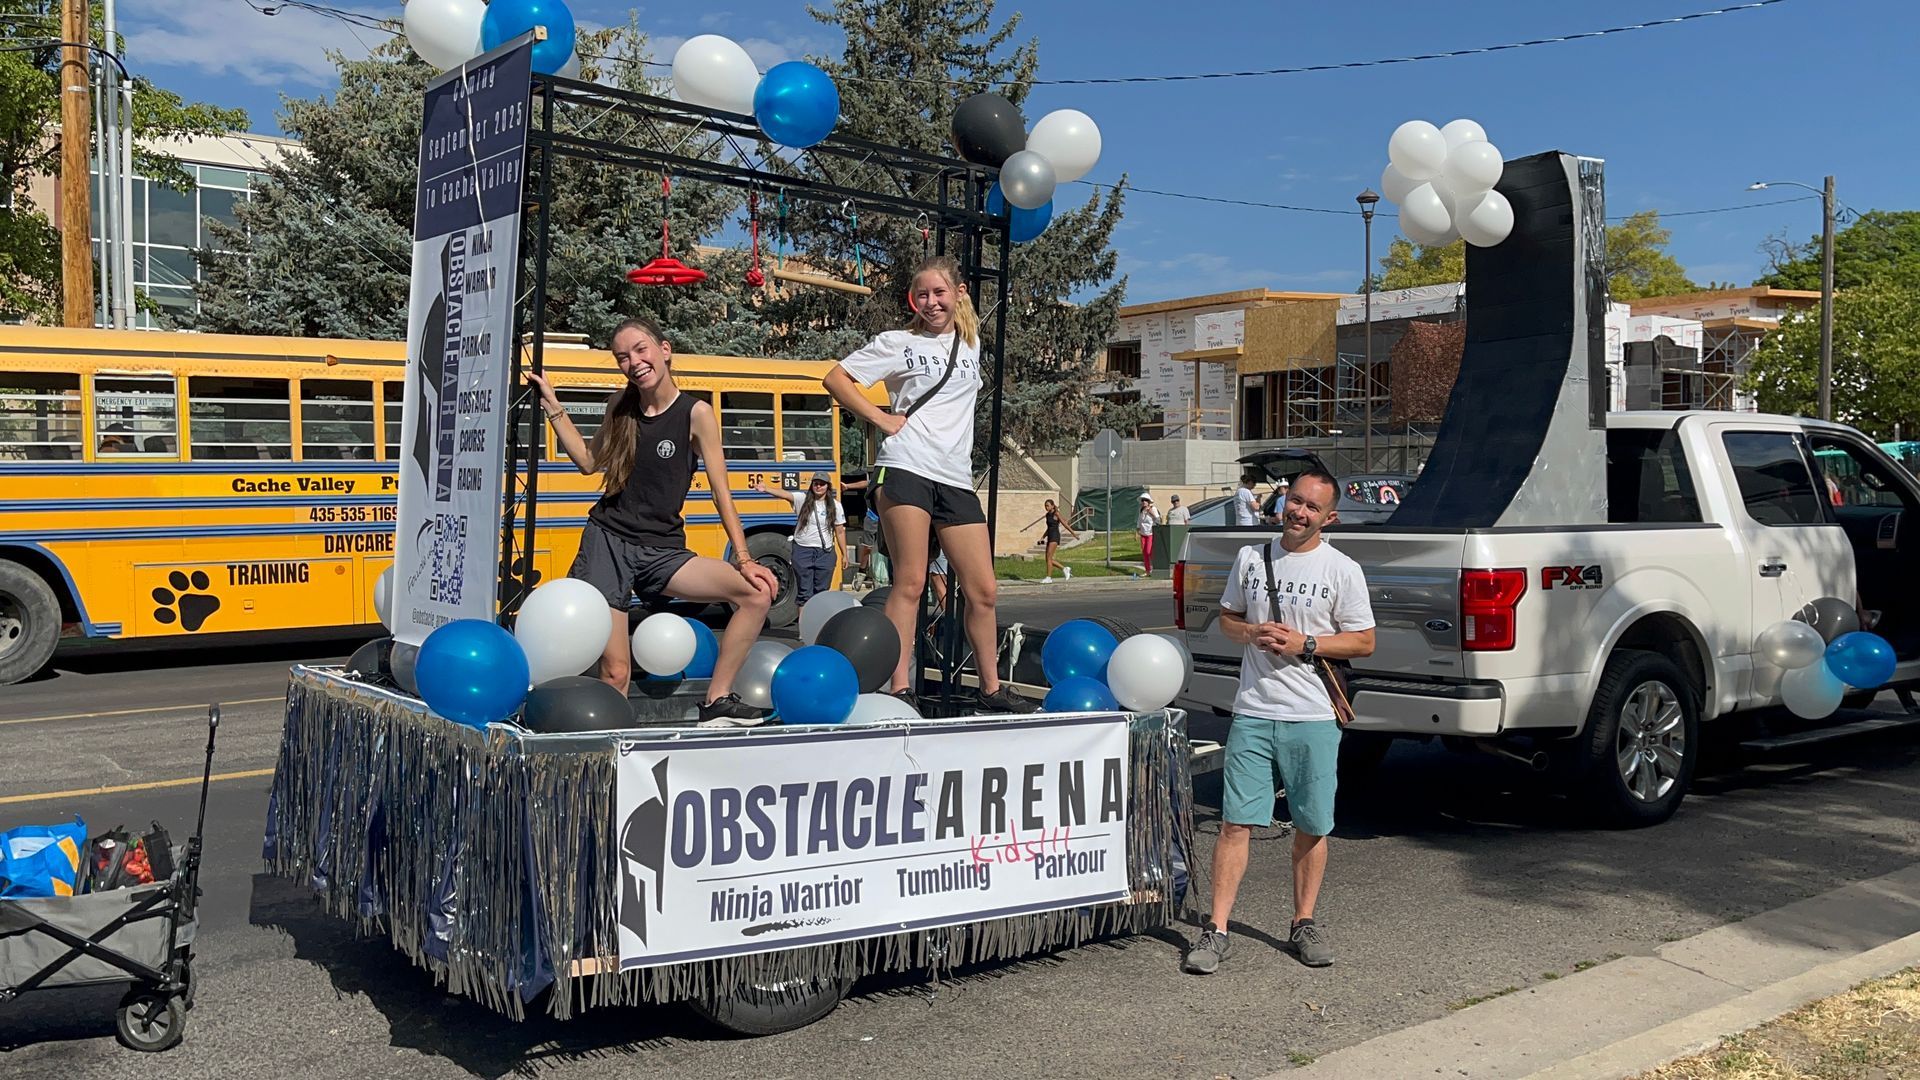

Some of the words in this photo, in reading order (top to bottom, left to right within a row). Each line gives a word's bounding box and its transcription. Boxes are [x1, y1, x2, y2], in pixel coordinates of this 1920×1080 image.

[428, 119, 487, 161] Septemer
[495, 101, 522, 135] 2025
[425, 188, 436, 210] To
[441, 175, 475, 204] Cache
[481, 158, 520, 191] Valley
[445, 236, 466, 362] OBSTACLE
[460, 333, 491, 358] PARKOUR
[925, 365, 977, 380] Arna
[458, 389, 492, 414] OBSTACLE
[436, 371, 459, 499] ARENA
[460, 429, 486, 452] COURSE
[232, 478, 291, 492] Cache
[297, 476, 355, 493] Valley
[457, 467, 482, 491] RACING
[325, 534, 393, 553] DAYCARE
[227, 563, 309, 586] TRAINING
[1541, 565, 1603, 590] FX4
[670, 772, 928, 868] OBSTACLE
[935, 758, 1124, 840] ARENA
[710, 885, 773, 922] Ninja
[780, 874, 863, 914] Warrior
[896, 860, 991, 898] Tumbling
[1034, 849, 1107, 880] Parkour
